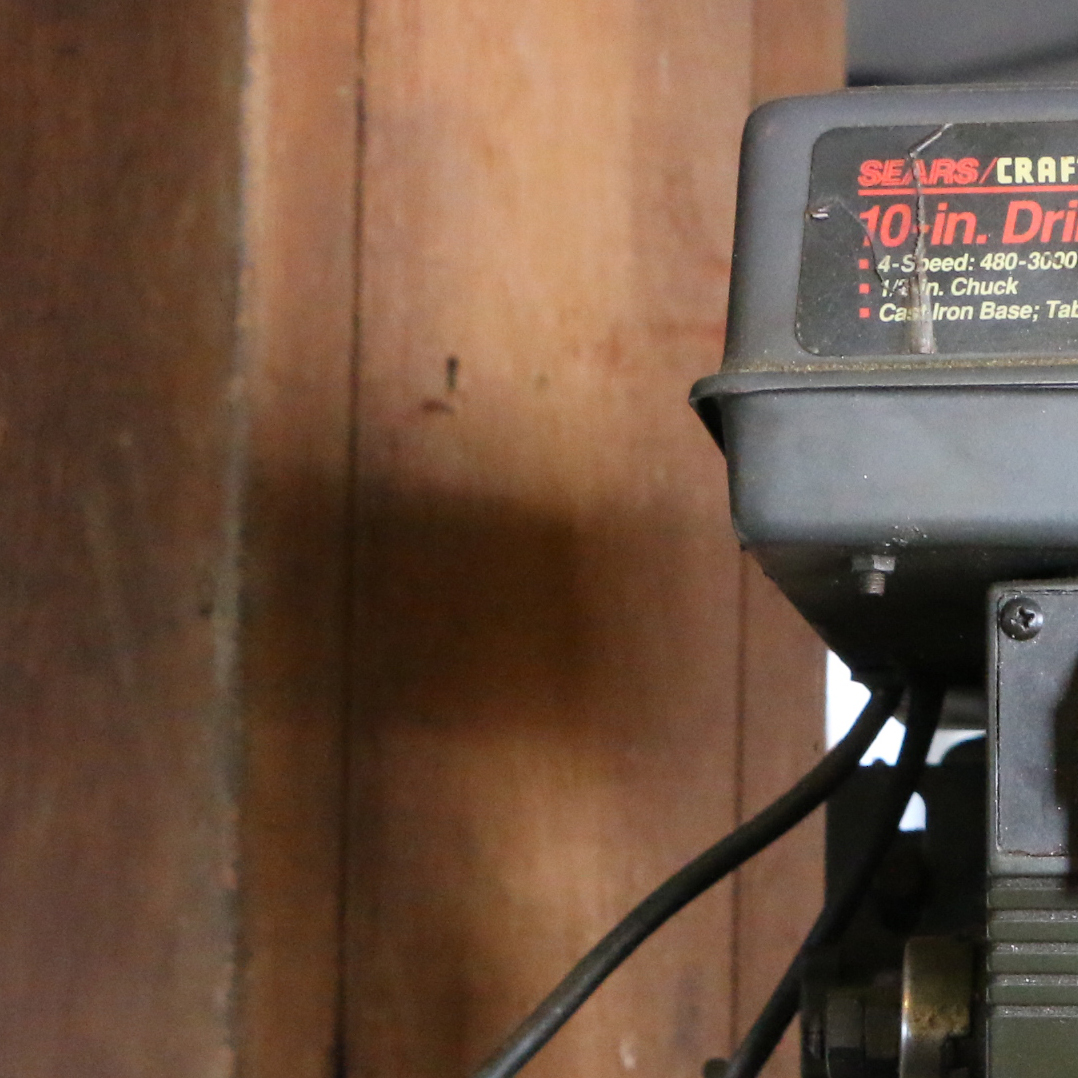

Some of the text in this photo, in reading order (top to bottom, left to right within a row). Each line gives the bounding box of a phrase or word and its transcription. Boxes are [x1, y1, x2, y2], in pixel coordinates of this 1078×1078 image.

[859, 203, 987, 246] 10-in.
[980, 251, 1078, 271] 480-3000
[951, 277, 1018, 297] Chuck
[933, 302, 976, 321] Iron
[979, 301, 1039, 323] Base;
